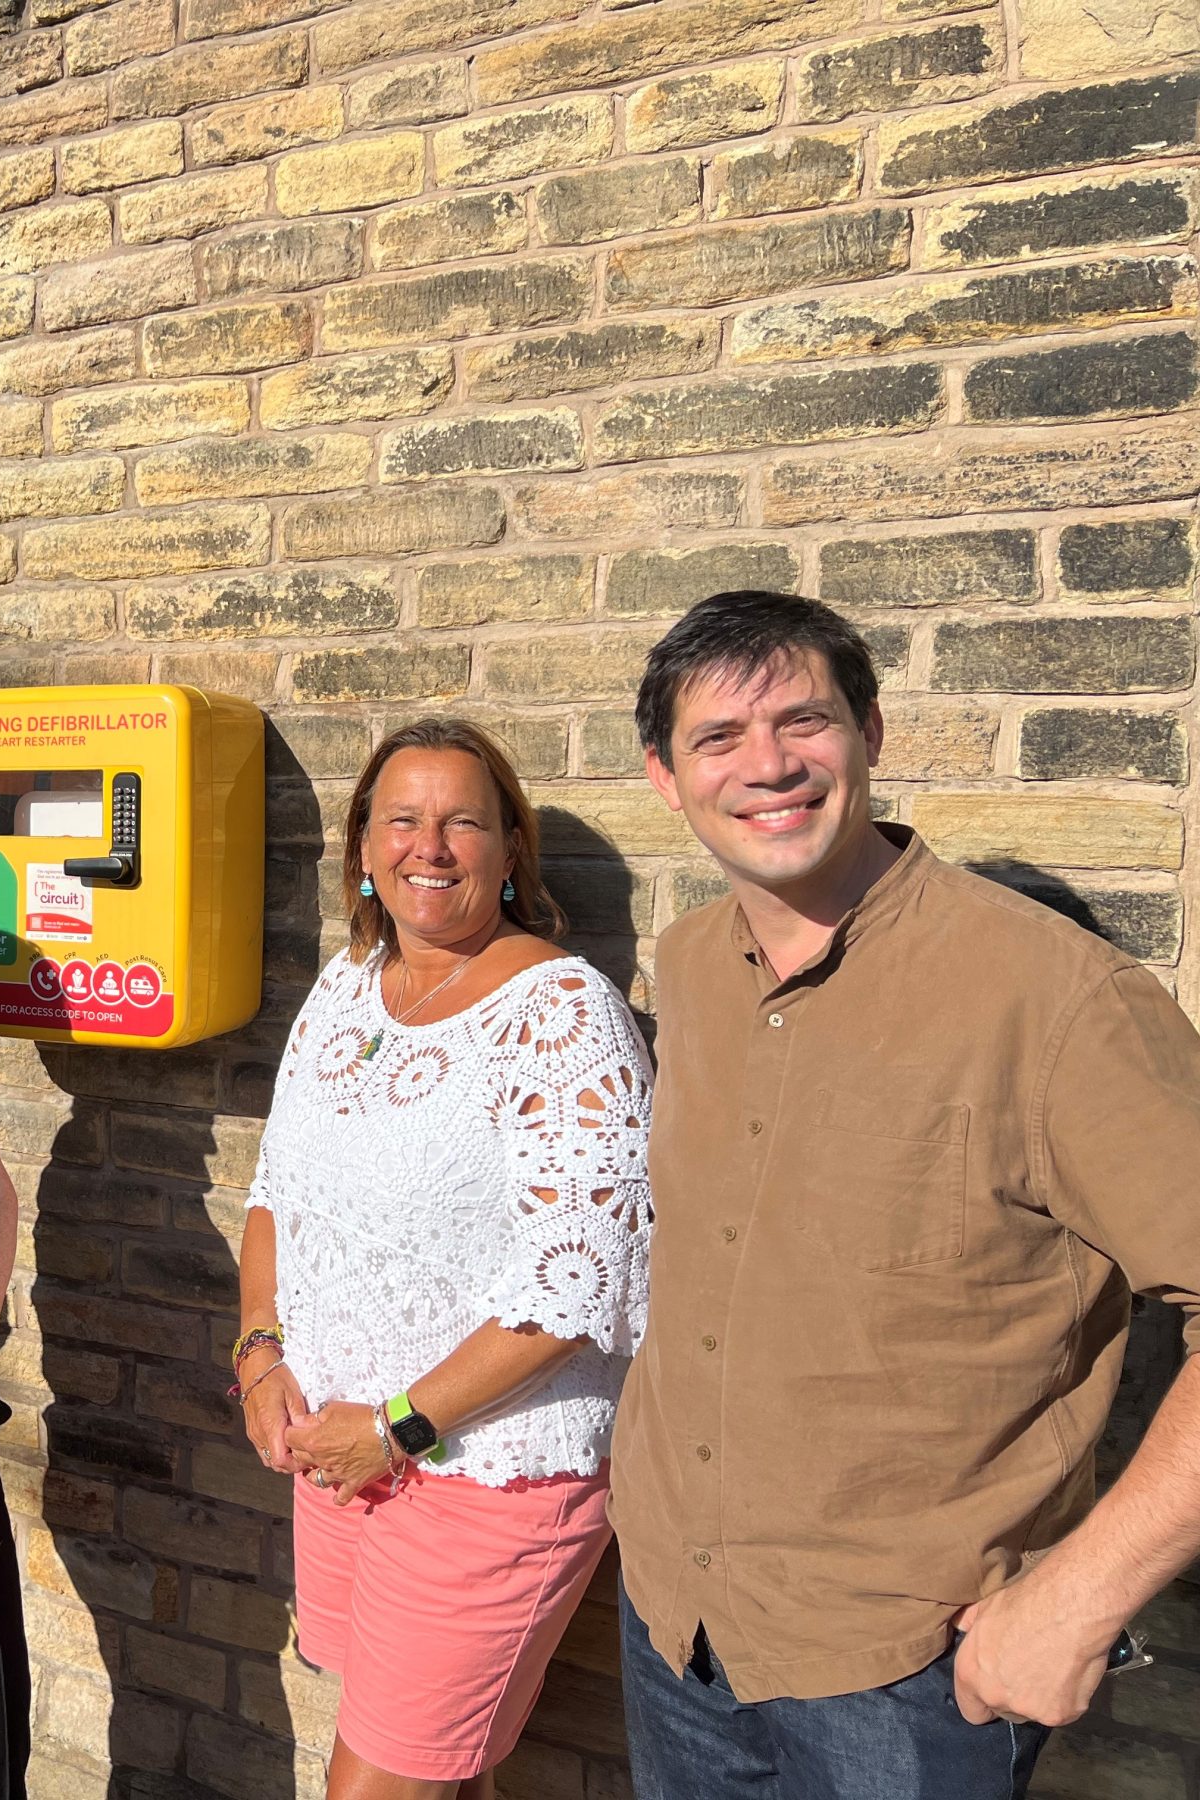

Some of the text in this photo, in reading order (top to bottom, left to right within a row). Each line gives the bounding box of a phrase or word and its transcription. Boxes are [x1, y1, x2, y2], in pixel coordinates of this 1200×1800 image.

[27, 713, 167, 732] DEFIBRILLATOR
[24, 736, 86, 747] RESTARTER
[40, 881, 55, 890] The
[40, 892, 79, 905] circuit
[95, 953, 109, 963] AED
[125, 955, 139, 966] Post
[158, 966, 167, 982] Care
[0, 1004, 17, 1014] FOR
[19, 1006, 53, 1017] ACCESS
[54, 1009, 80, 1018] CODE
[82, 1010, 95, 1020] TO
[96, 1012, 123, 1022] OPEN
